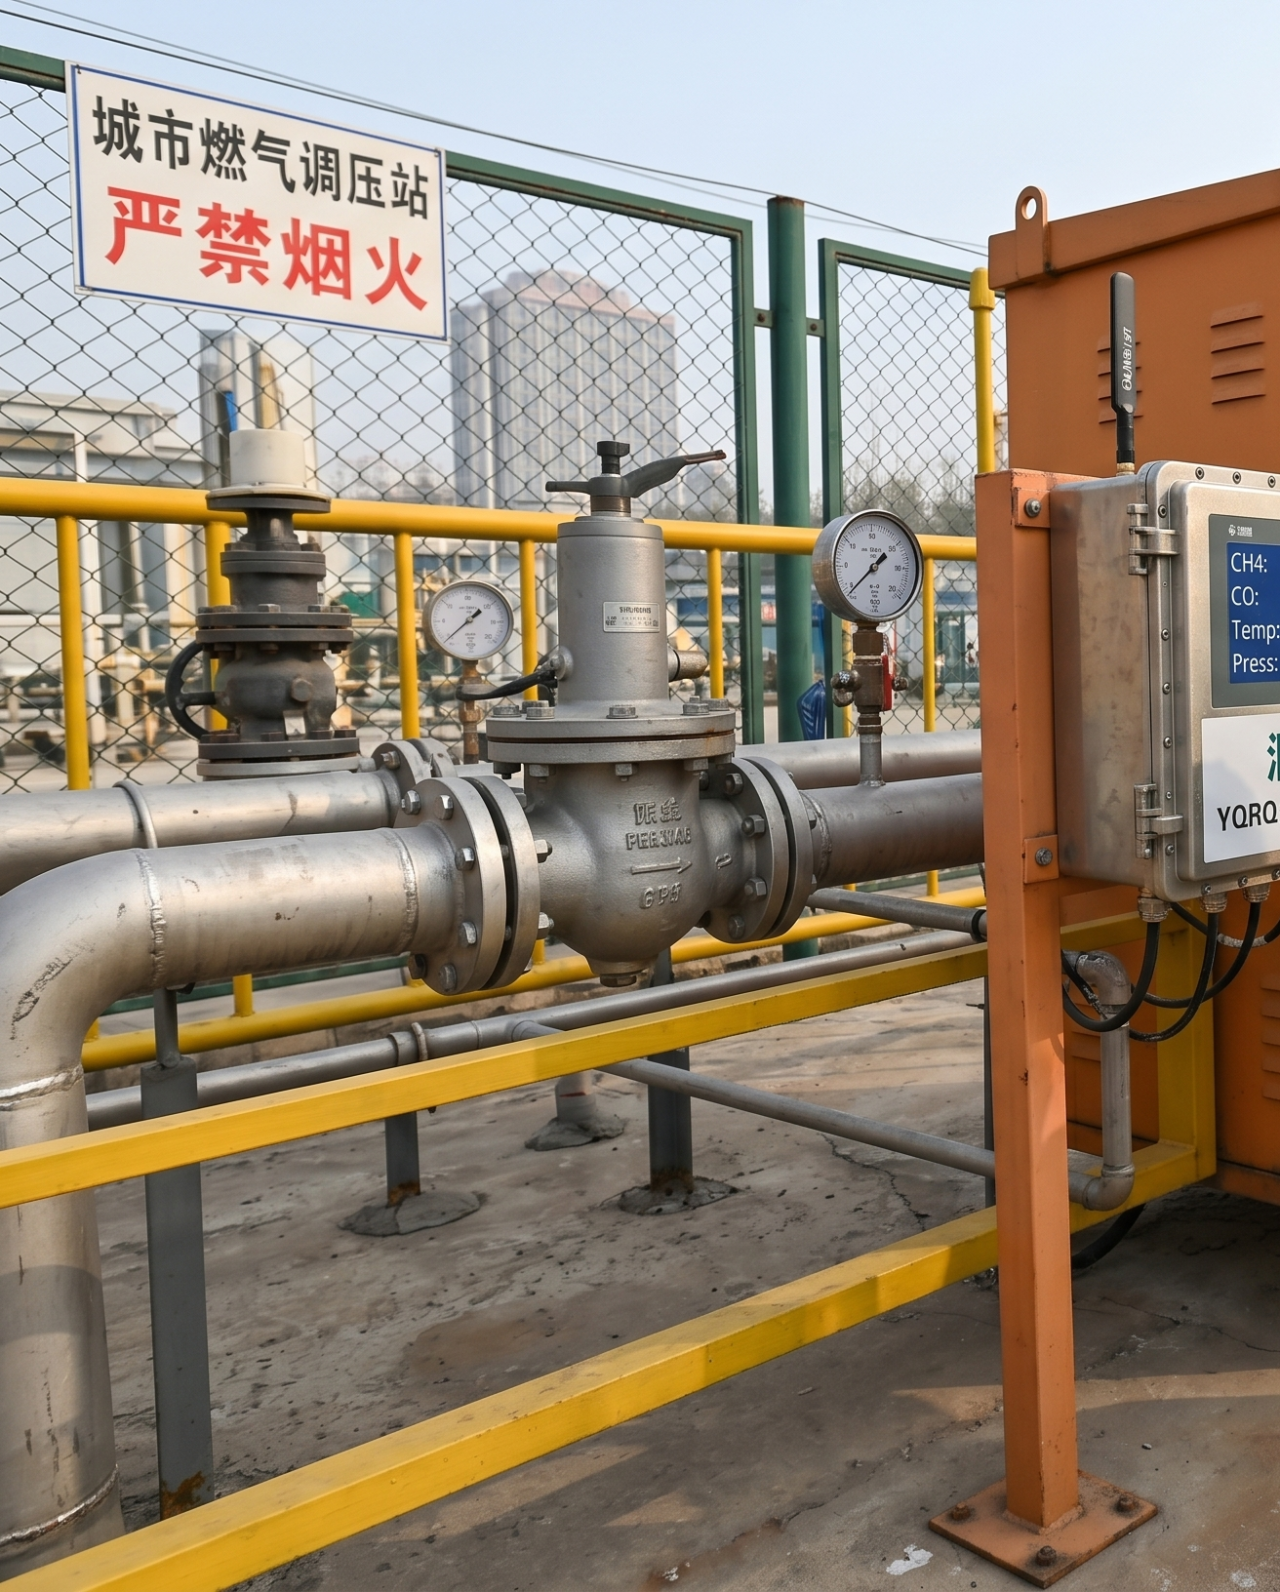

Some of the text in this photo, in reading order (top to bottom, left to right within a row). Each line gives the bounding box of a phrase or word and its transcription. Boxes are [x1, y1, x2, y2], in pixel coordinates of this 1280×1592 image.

[92, 95, 429, 220] 城市燃气调压站
[105, 186, 428, 311] 严禁烟火
[1230, 552, 1267, 573] CH4:
[1231, 586, 1259, 606] CO:
[1232, 619, 1280, 645] Temp:
[1233, 653, 1278, 673] Press:
